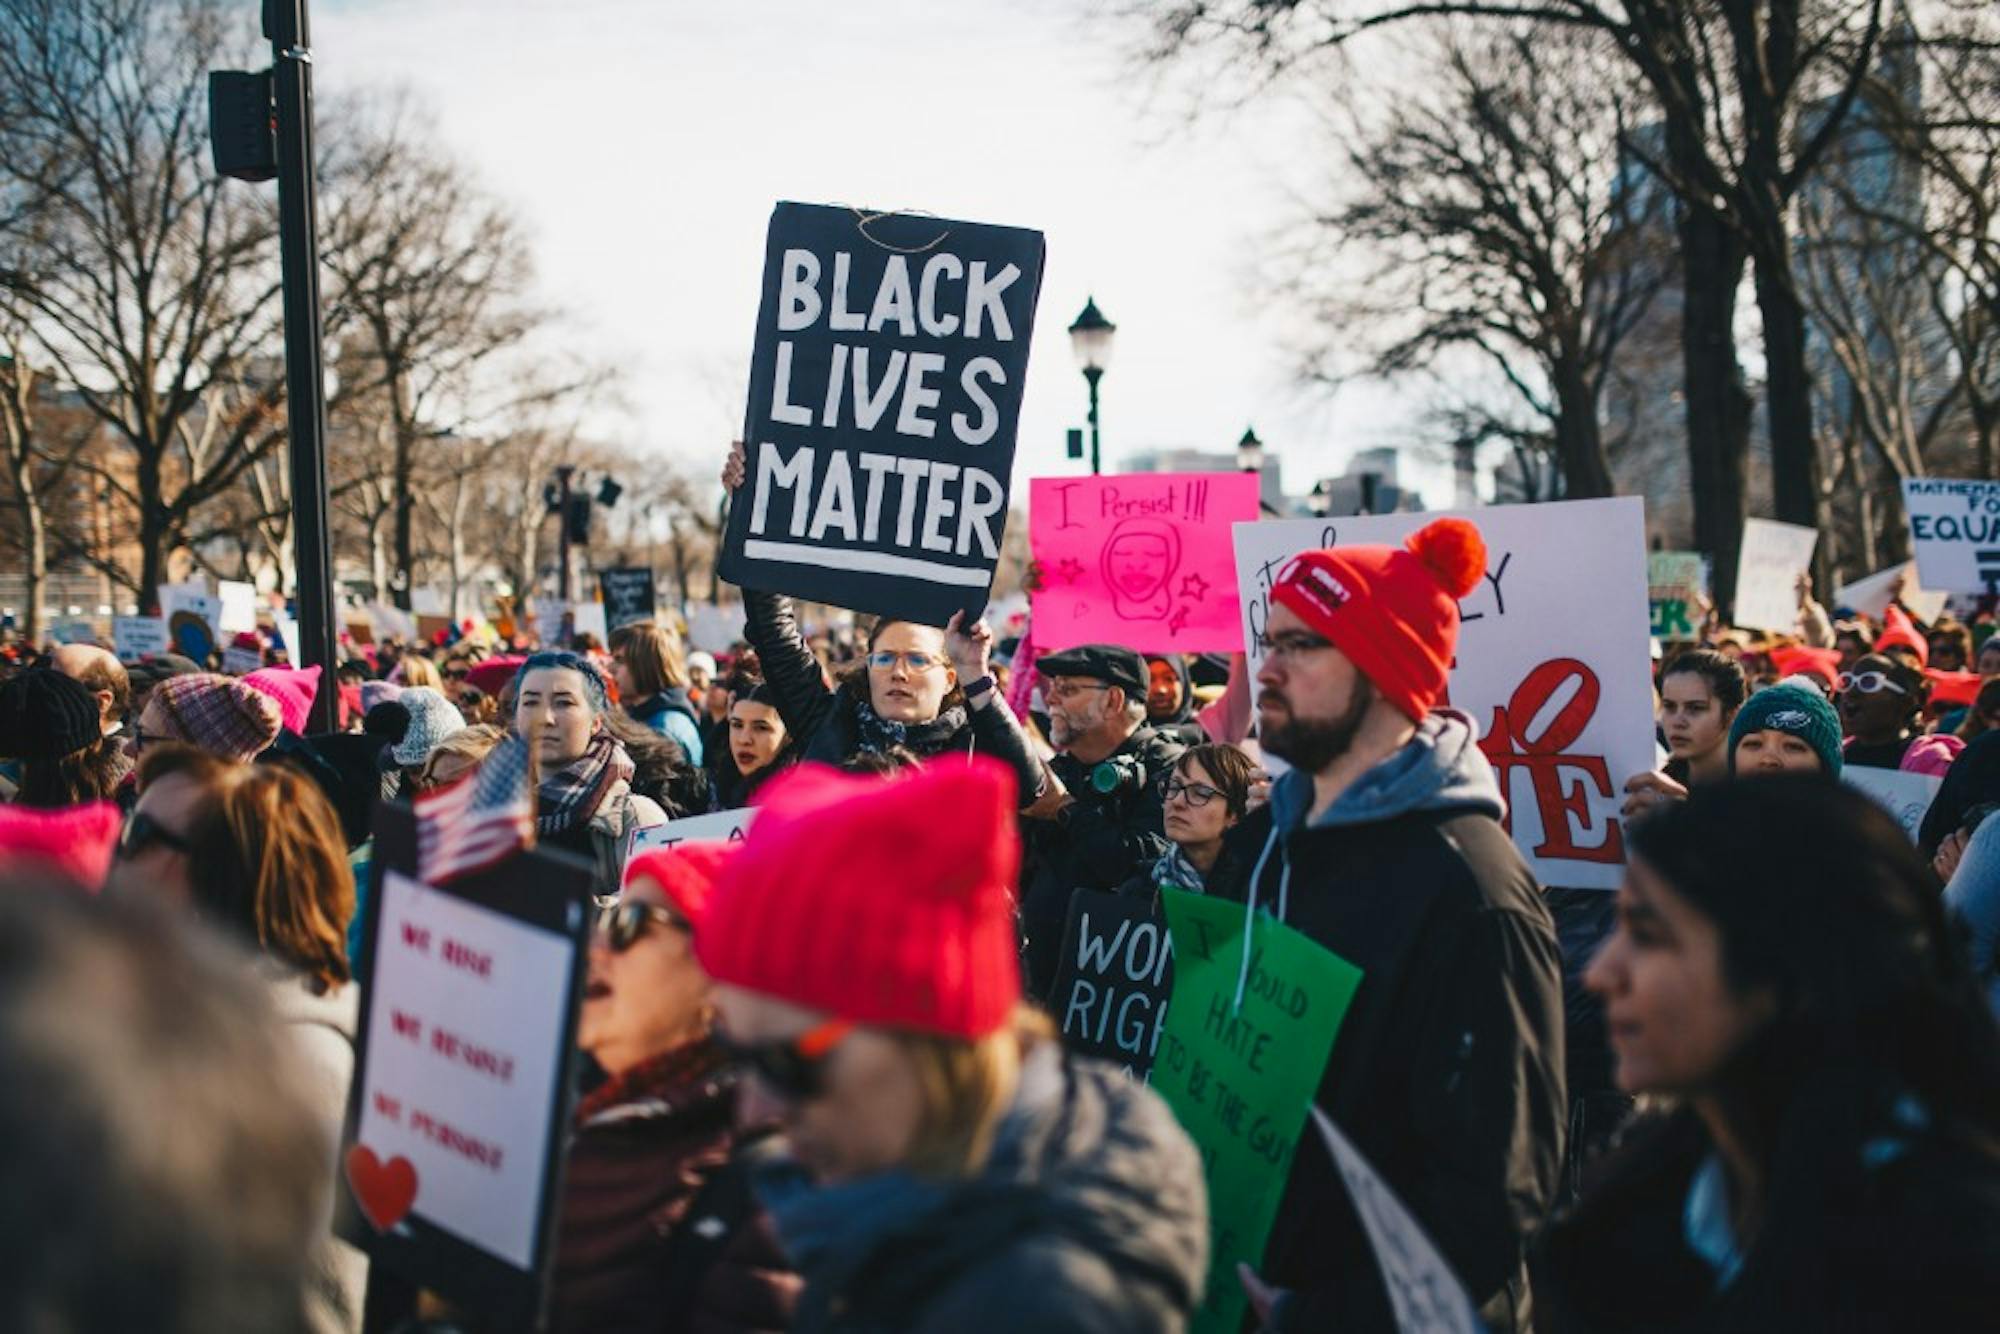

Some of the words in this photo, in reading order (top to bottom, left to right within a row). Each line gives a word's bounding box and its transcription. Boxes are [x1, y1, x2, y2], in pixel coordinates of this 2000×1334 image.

[776, 248, 1022, 342] BLACK
[770, 340, 1008, 447] LIVES
[748, 441, 1004, 560] MATTER
[1053, 483, 1085, 530] I
[1101, 479, 1209, 524] Persist!!!
[1440, 656, 1601, 755] O
[1486, 753, 1626, 864] E
[402, 922, 430, 959] WE
[1186, 916, 1217, 964] I
[1204, 990, 1273, 1075] HATE
[1249, 1114, 1290, 1165] GU
